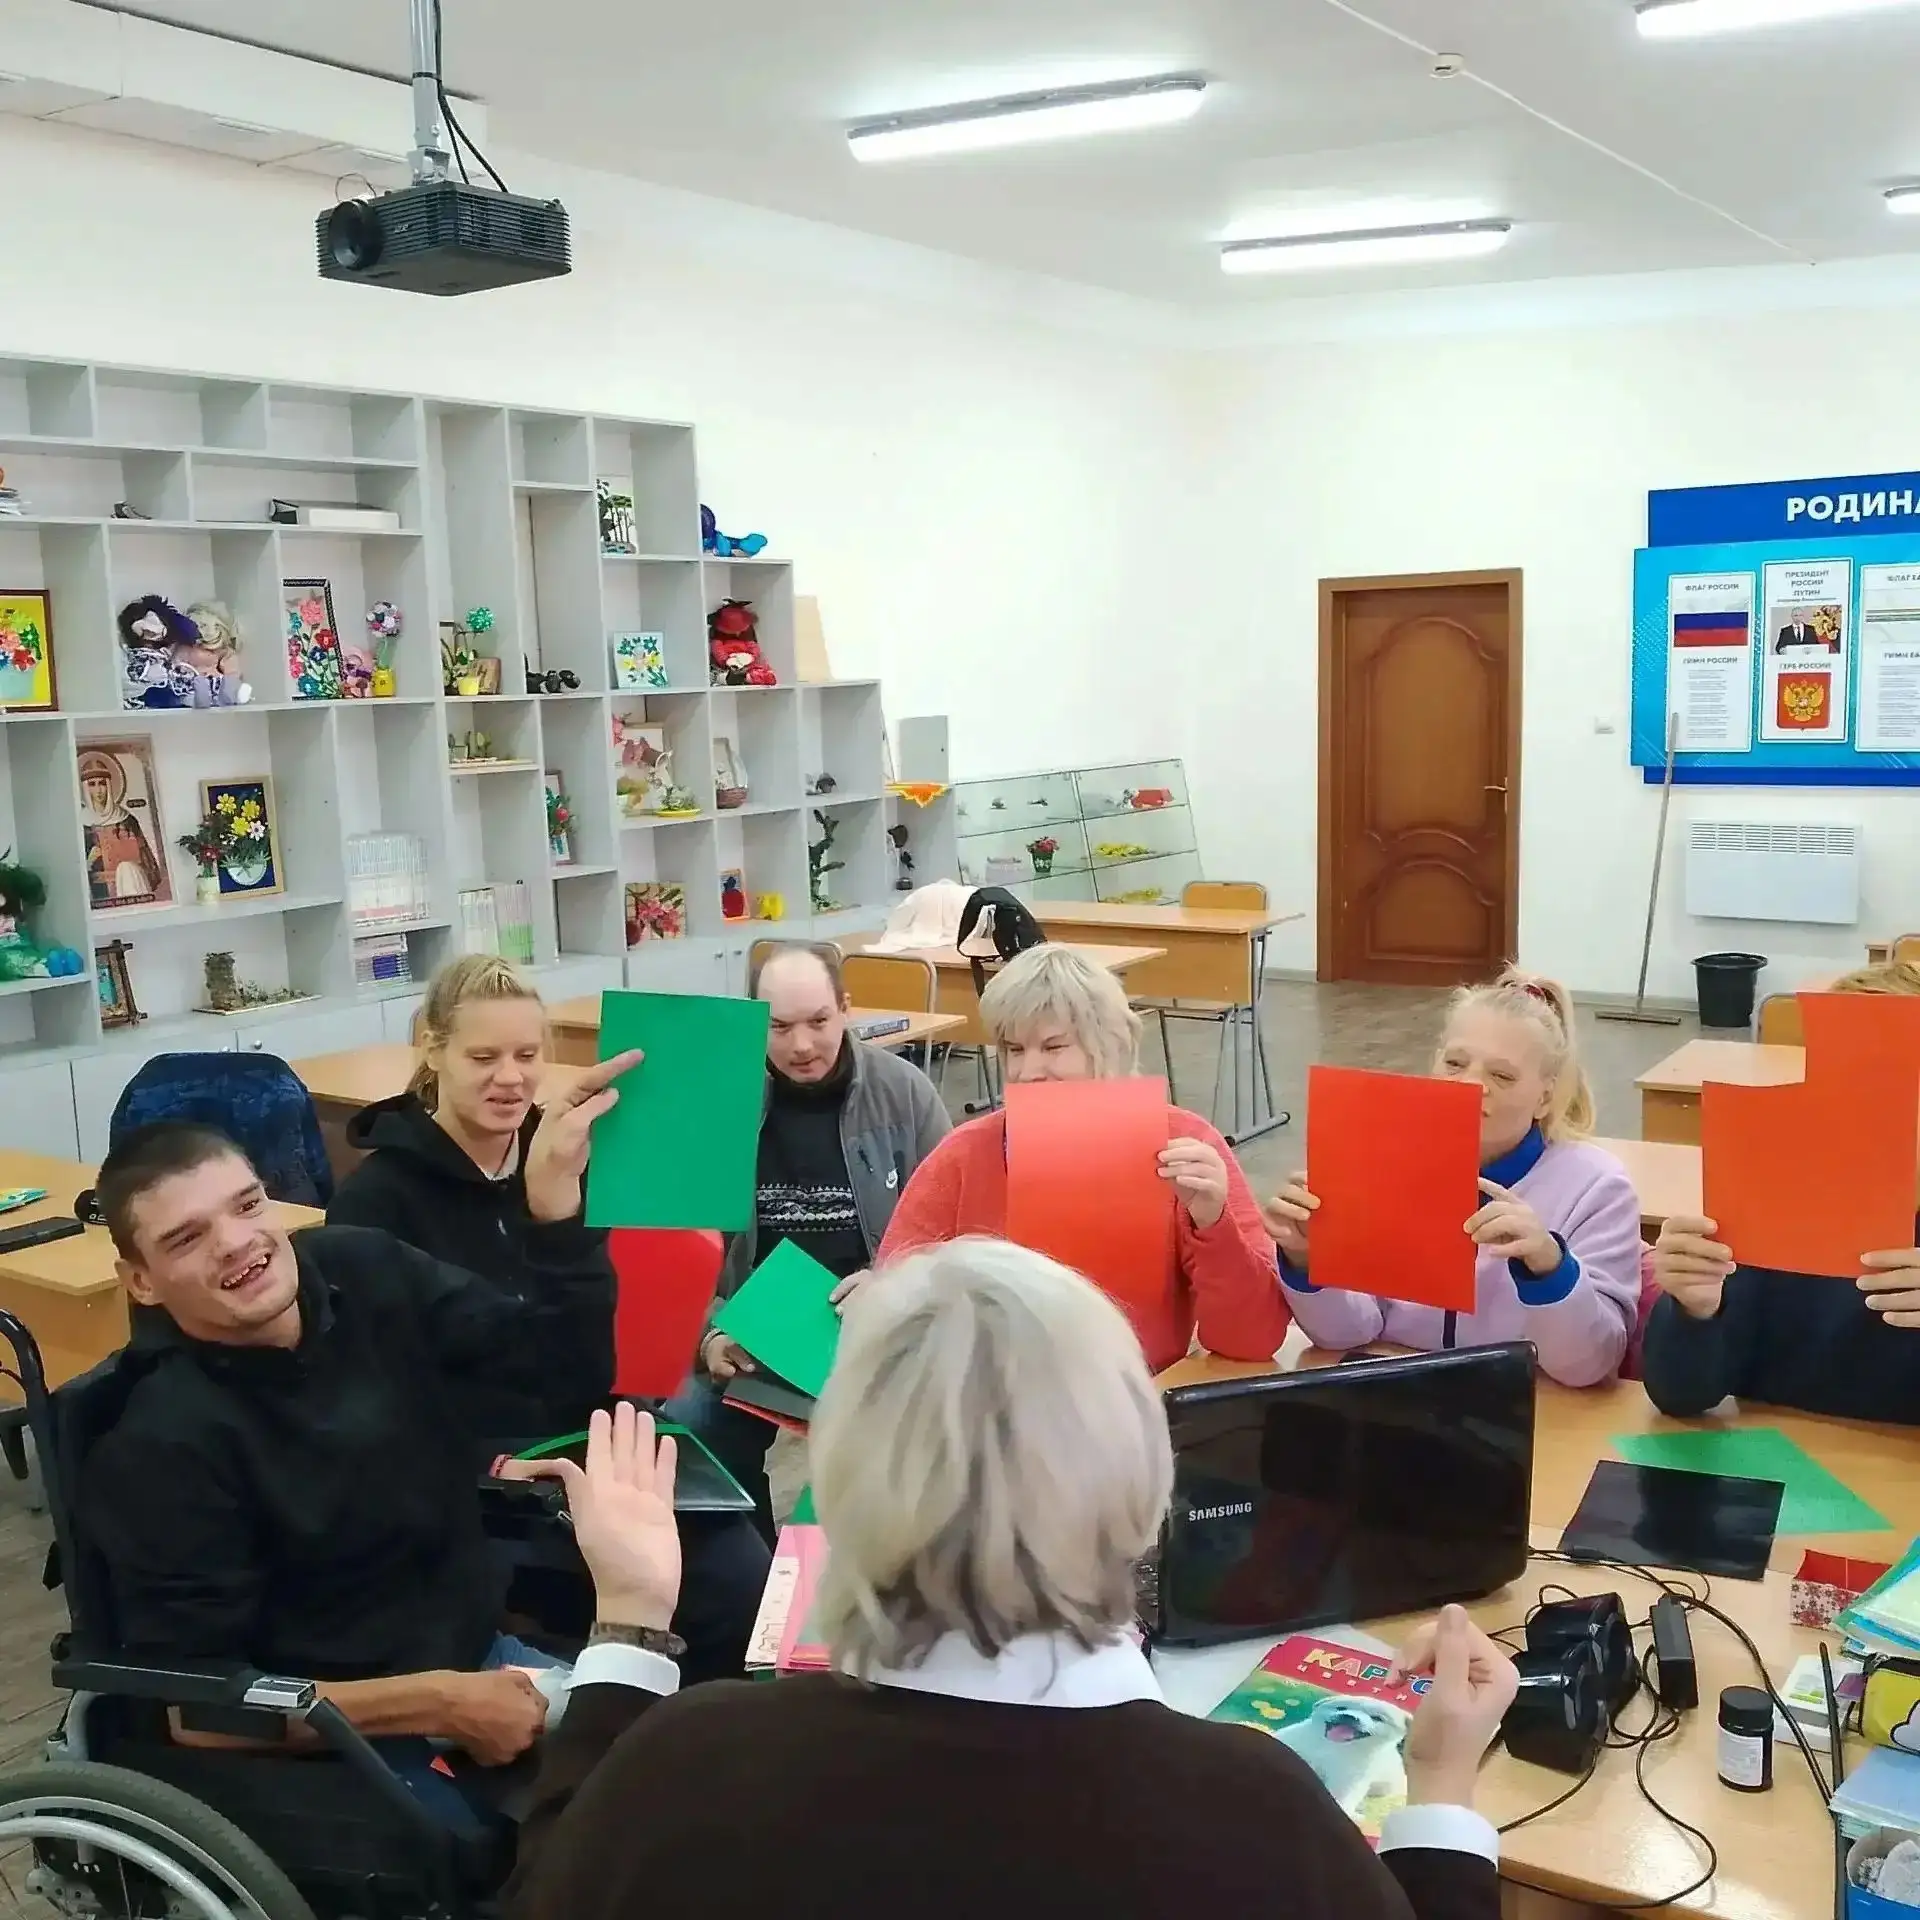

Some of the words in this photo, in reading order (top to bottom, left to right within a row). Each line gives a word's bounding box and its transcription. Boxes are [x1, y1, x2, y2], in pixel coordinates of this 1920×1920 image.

[1786, 489, 1920, 524] РОДИН
[1785, 570, 1830, 579] ПРЕЗИДЕНТ
[1707, 583, 1740, 591] РОССИИ
[1791, 579, 1824, 588] РОССИИ
[1793, 589, 1821, 597] ПУТИН
[1707, 656, 1738, 664] РОССИИ
[1798, 662, 1832, 670] РОССИИ
[1188, 1502, 1253, 1522] SAMSUNG
